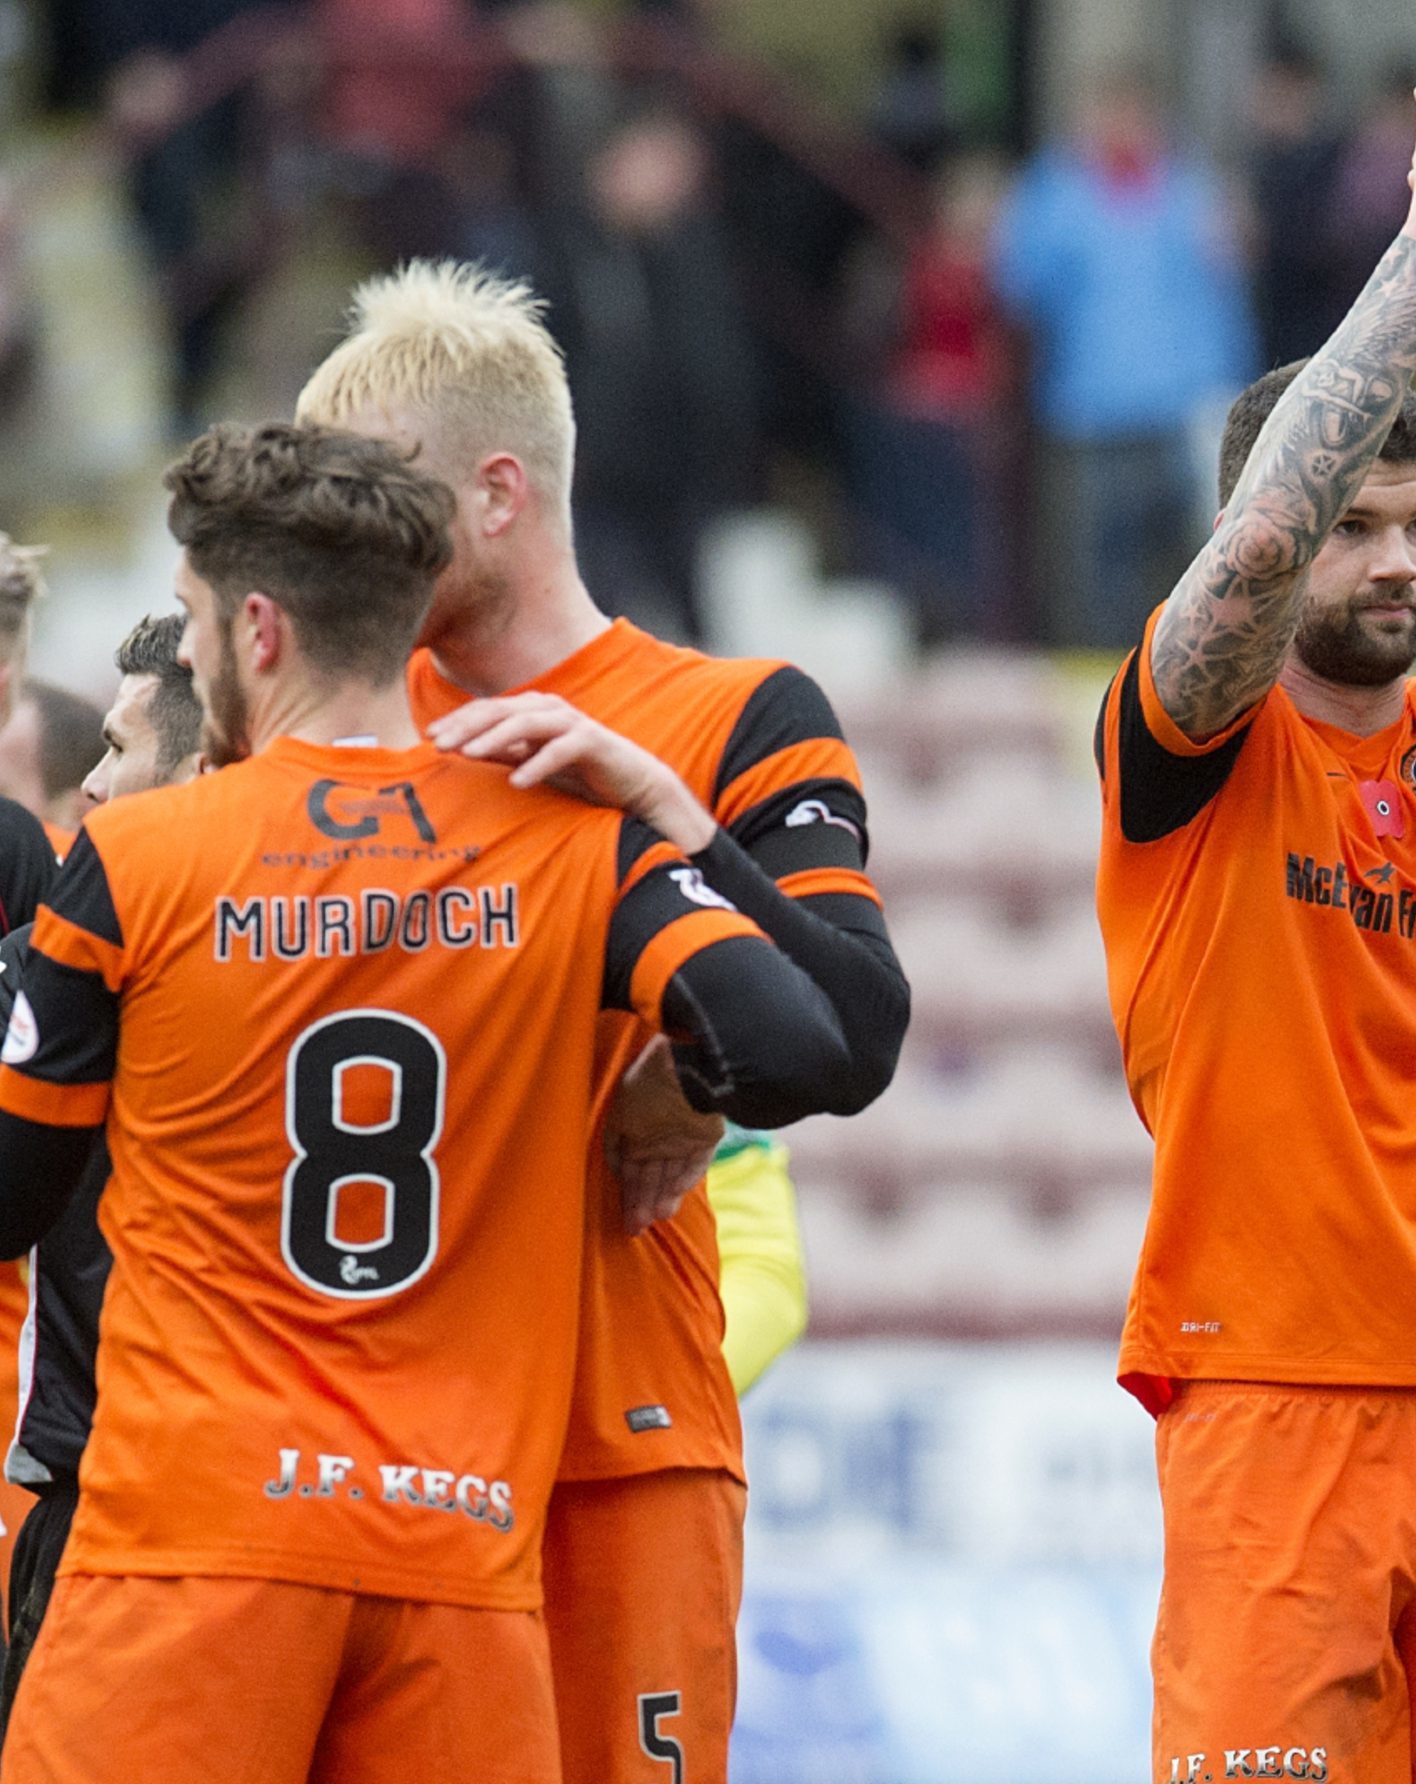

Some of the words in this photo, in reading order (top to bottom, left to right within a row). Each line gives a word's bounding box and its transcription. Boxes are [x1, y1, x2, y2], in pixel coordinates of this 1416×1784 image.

[215, 882, 521, 964] MURDOCH
[280, 1007, 448, 1301] 8
[264, 1447, 364, 1501] J.F.
[378, 1463, 515, 1534] KEGS
[636, 1689, 687, 1784] 5
[1222, 1745, 1329, 1783] KEGS
